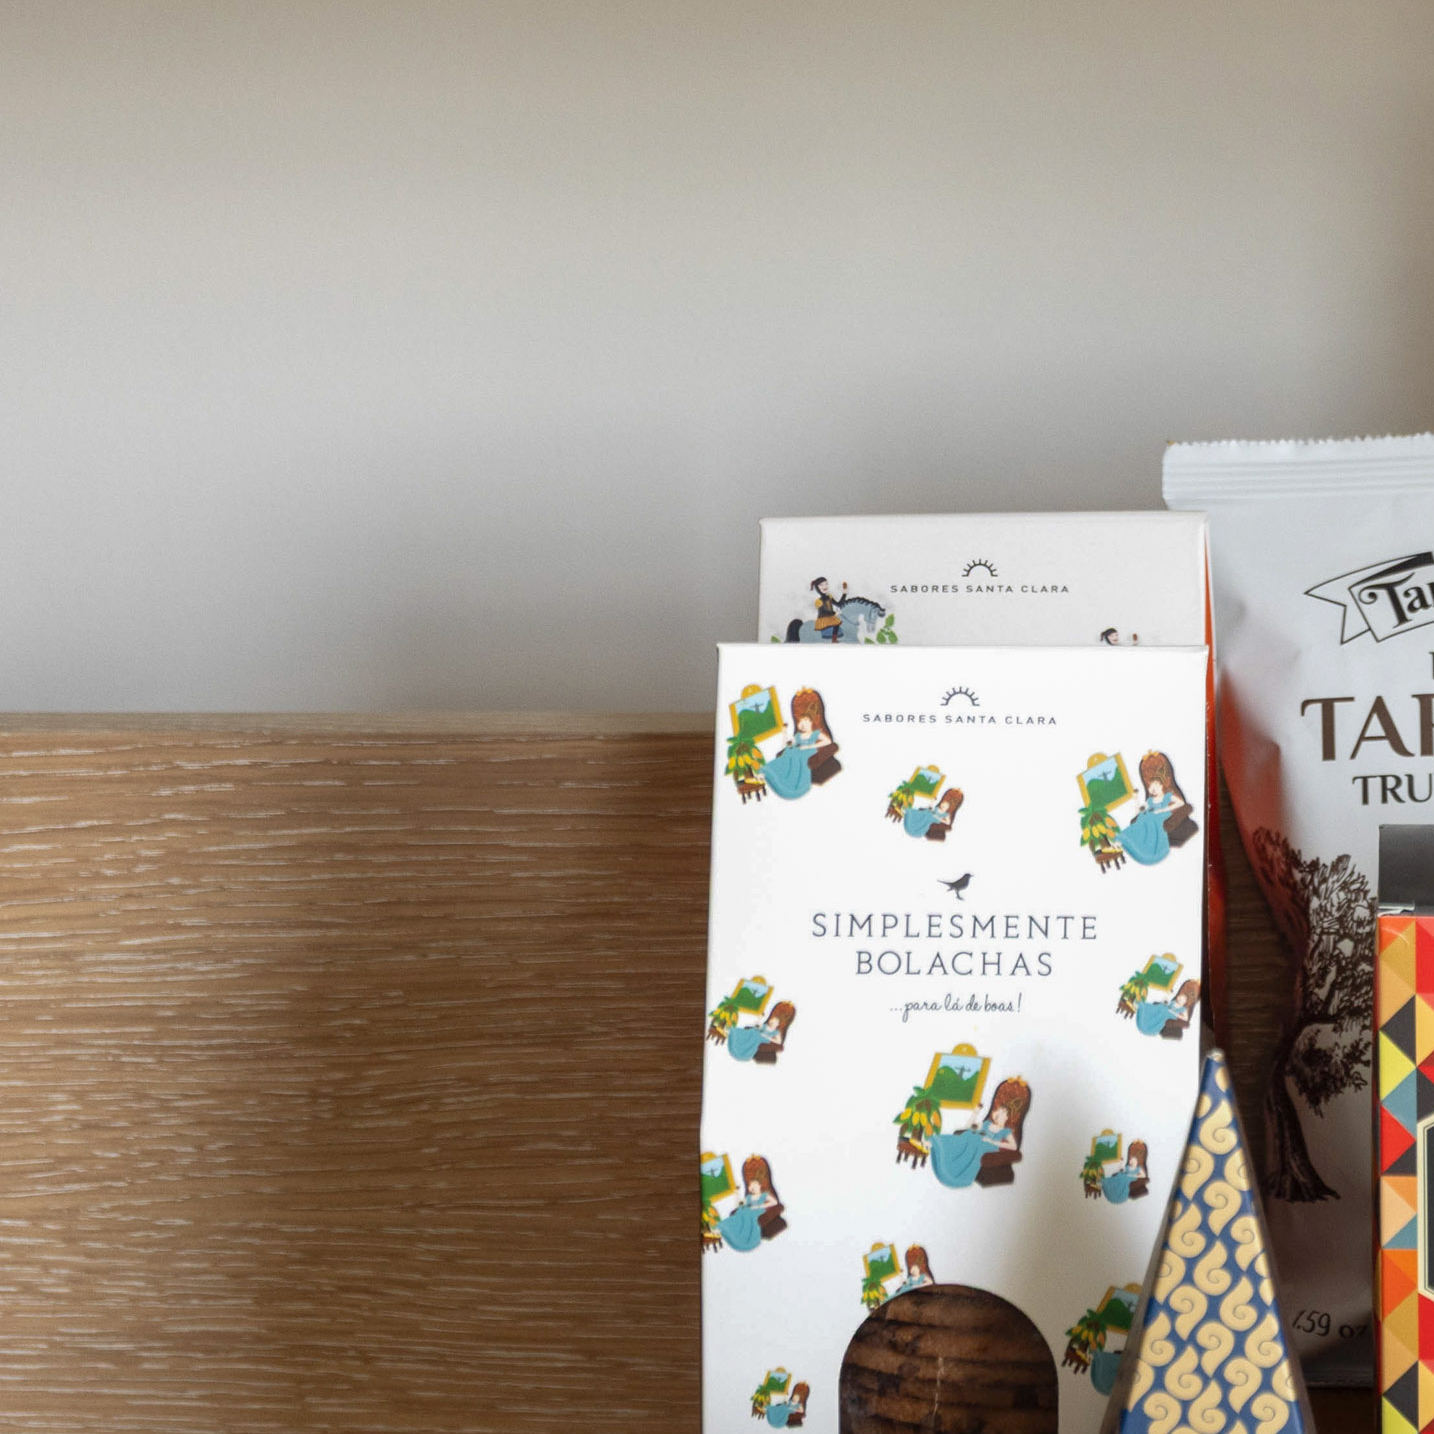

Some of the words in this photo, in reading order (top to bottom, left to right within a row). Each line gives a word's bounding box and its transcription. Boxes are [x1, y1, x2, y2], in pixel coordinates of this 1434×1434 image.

[890, 585, 959, 593] SABORES
[966, 585, 1013, 593] SANTA
[1021, 585, 1069, 593] CLARA
[862, 714, 937, 723] SABORES
[944, 715, 997, 724] SANTA
[1005, 716, 1057, 725] CLARA
[811, 913, 1098, 940] SIMPLESMENTE
[855, 950, 1053, 977] BOLACHAS
[944, 993, 963, 1012] lá
[965, 994, 982, 1012] de
[984, 992, 1022, 1012] boas!
